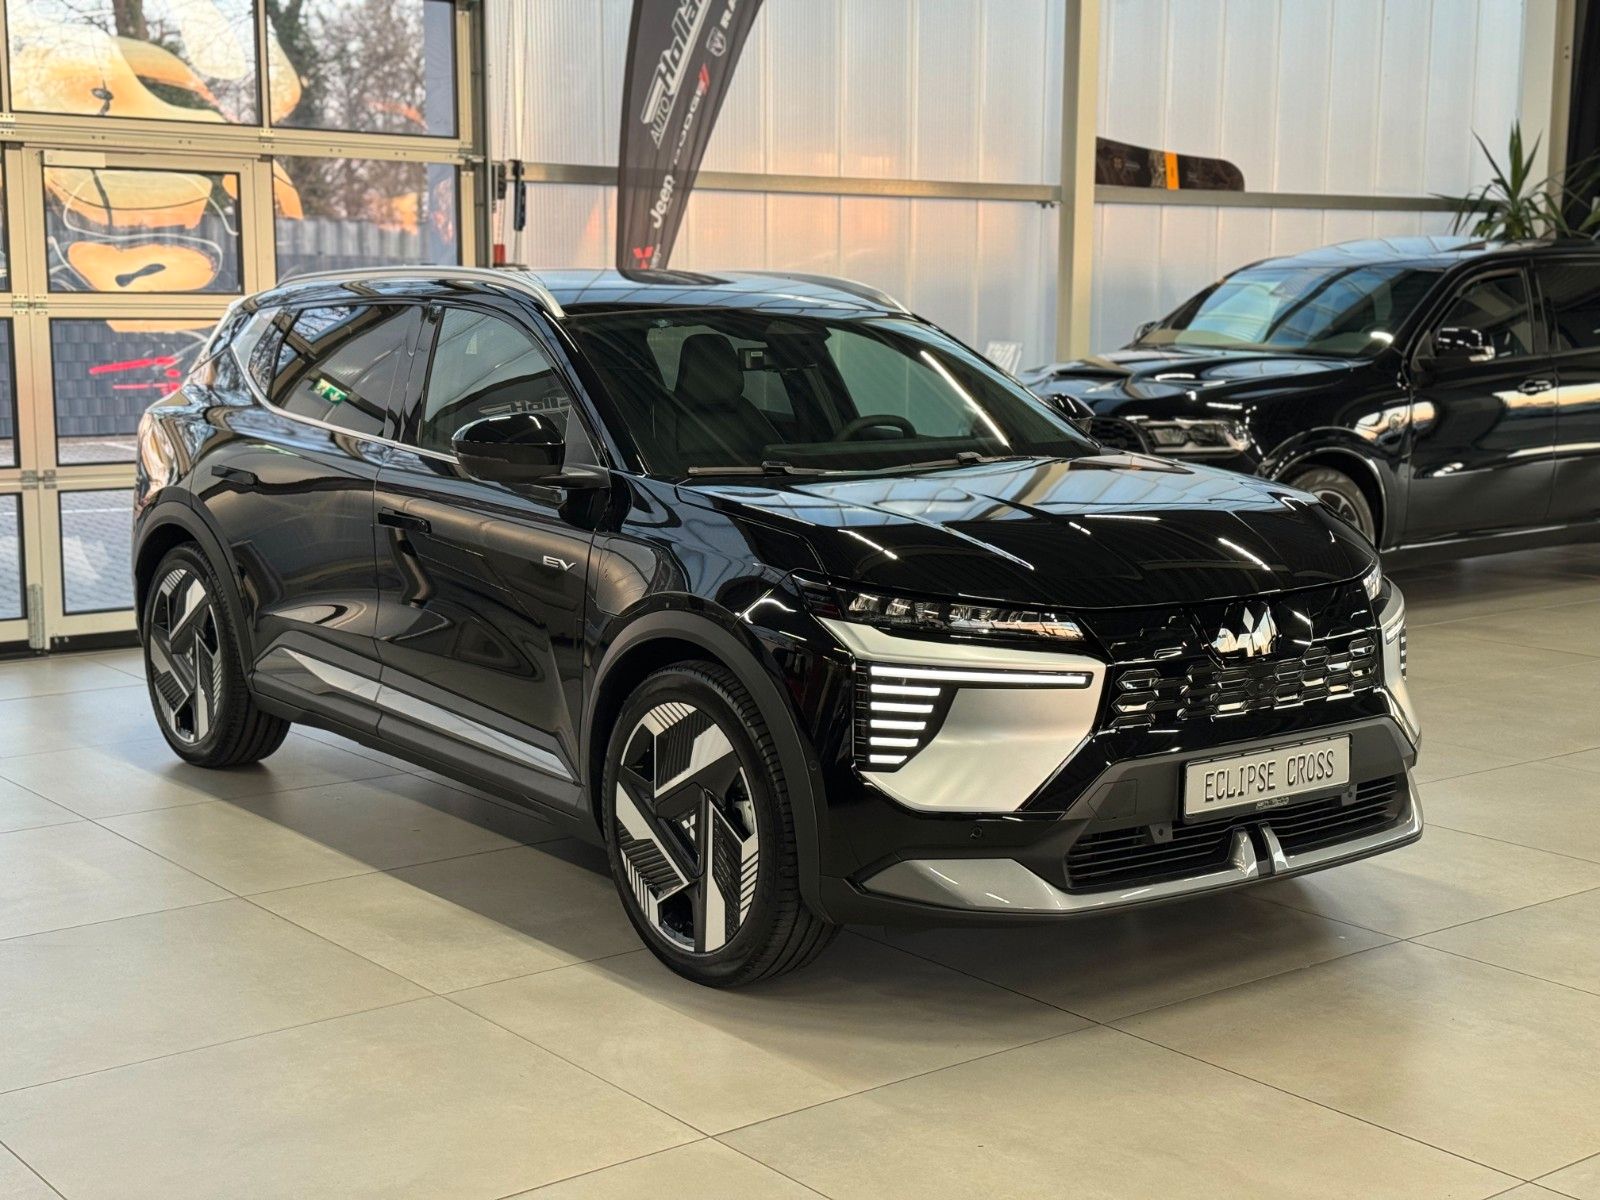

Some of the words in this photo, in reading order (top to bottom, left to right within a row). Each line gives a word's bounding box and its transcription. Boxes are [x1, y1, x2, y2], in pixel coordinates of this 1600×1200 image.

[650, 96, 671, 146] AUTO
[650, 174, 675, 229] Jeep
[543, 555, 577, 571] EV
[1204, 761, 1276, 802] ECLIPSE
[1287, 750, 1334, 786] CROSS
